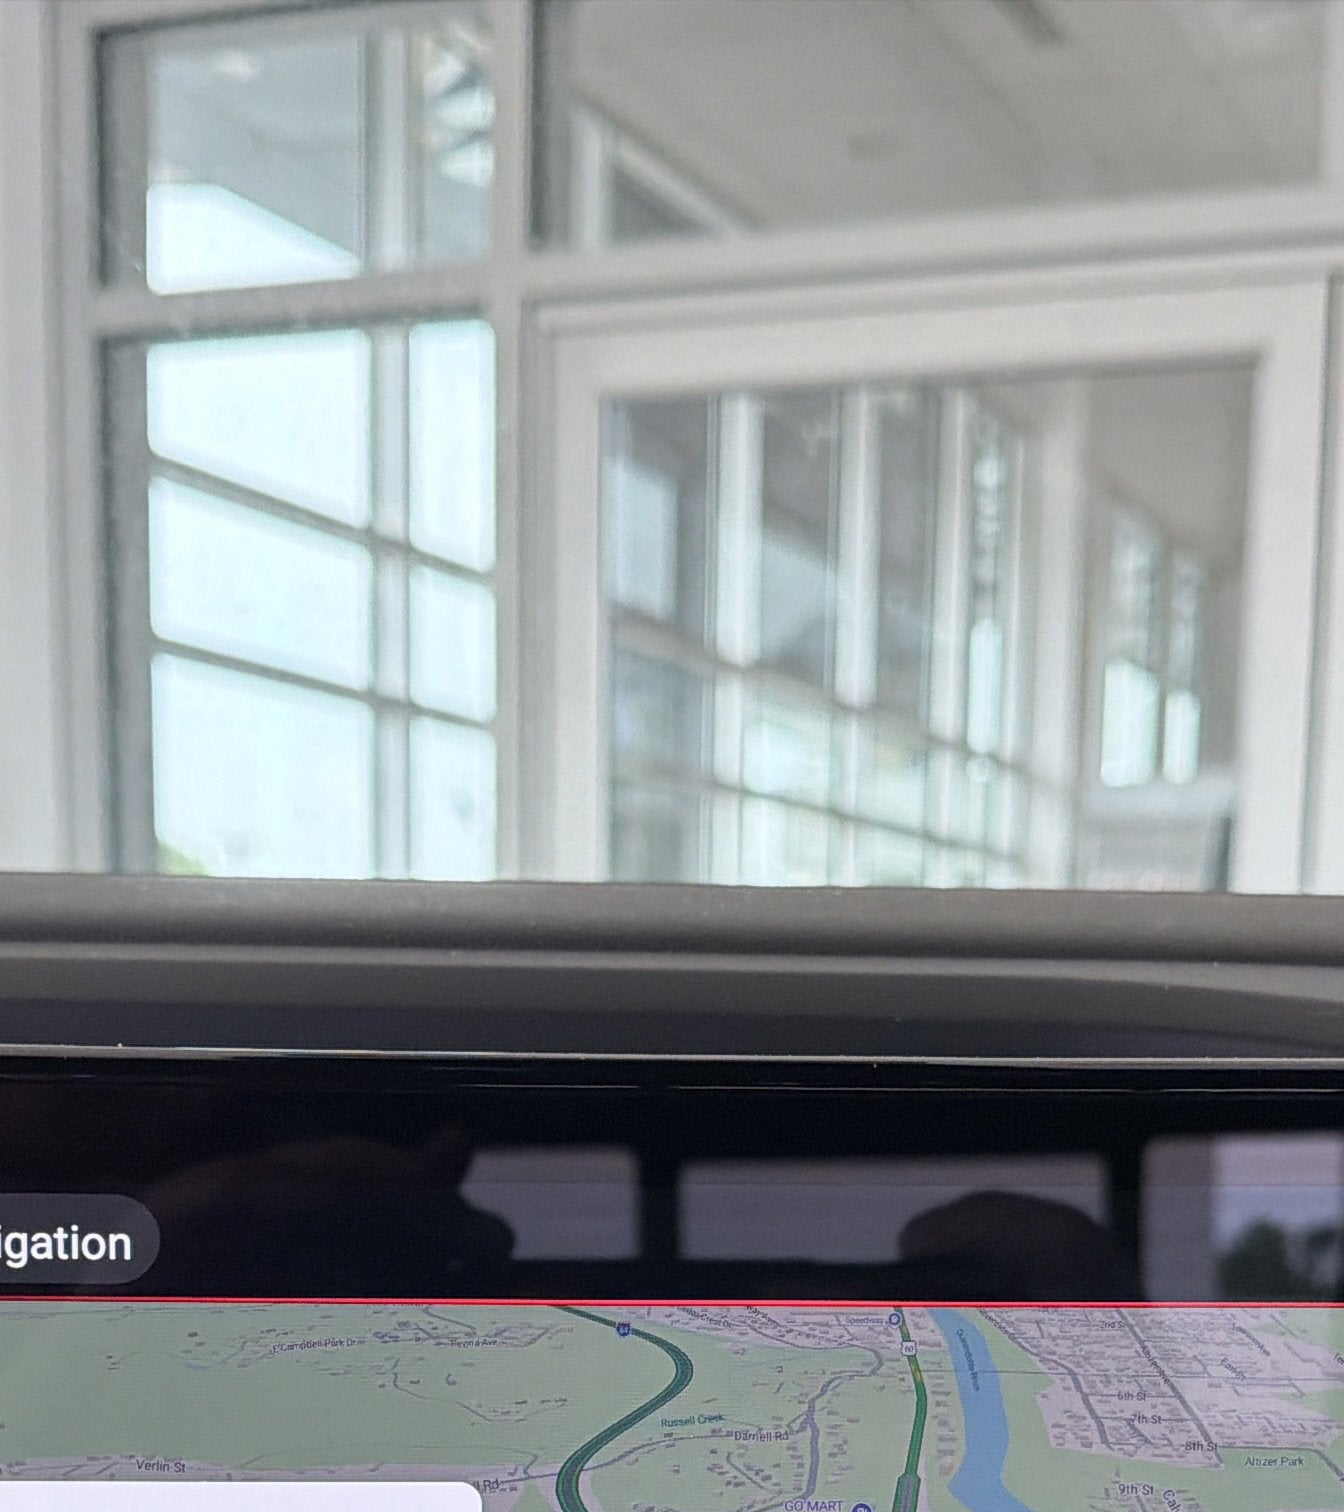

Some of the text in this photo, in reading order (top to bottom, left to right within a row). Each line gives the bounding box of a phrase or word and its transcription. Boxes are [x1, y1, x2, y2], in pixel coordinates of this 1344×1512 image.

[1117, 1391, 1147, 1401] 6th St
[661, 1412, 724, 1427] Russell Creek
[1131, 1414, 1162, 1424] 7th St
[774, 1431, 789, 1441] Rd
[1184, 1441, 1218, 1452] 8th St
[136, 1459, 186, 1473] Verlin St
[1244, 1456, 1304, 1467] Altizer Park
[483, 1479, 500, 1491] Rd
[1118, 1483, 1154, 1496] 9th St
[806, 1500, 844, 1512] MART
